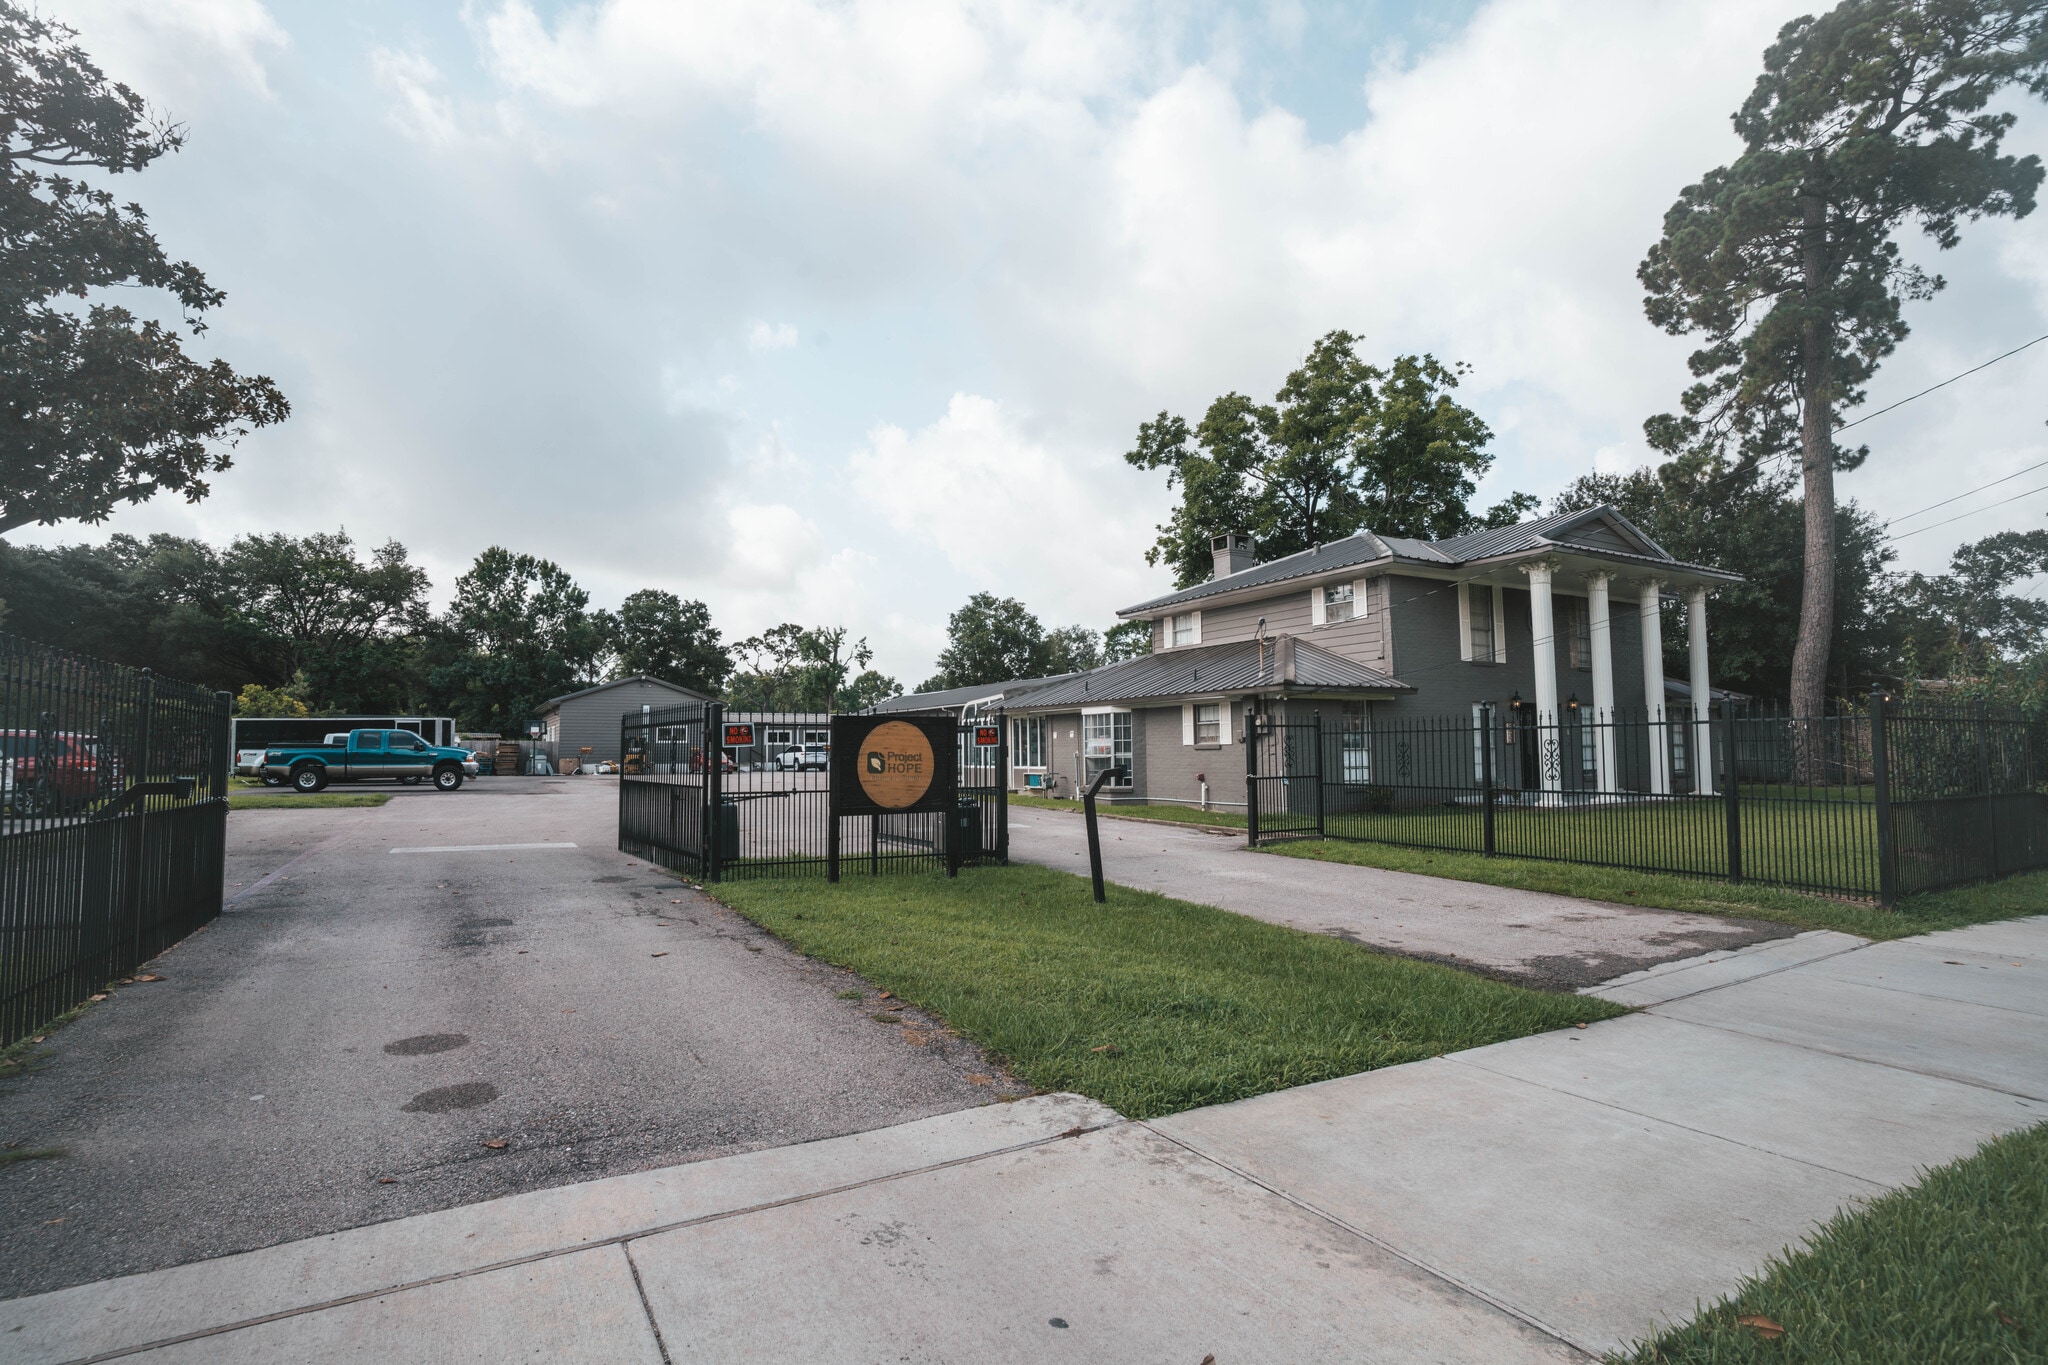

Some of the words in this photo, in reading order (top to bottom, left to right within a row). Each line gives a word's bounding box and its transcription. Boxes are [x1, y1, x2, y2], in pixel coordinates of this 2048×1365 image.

[729, 727, 738, 735] NO
[979, 729, 987, 737] NO
[726, 735, 752, 744] SMOKING
[887, 751, 922, 763] Project
[887, 763, 923, 774] HOPE
